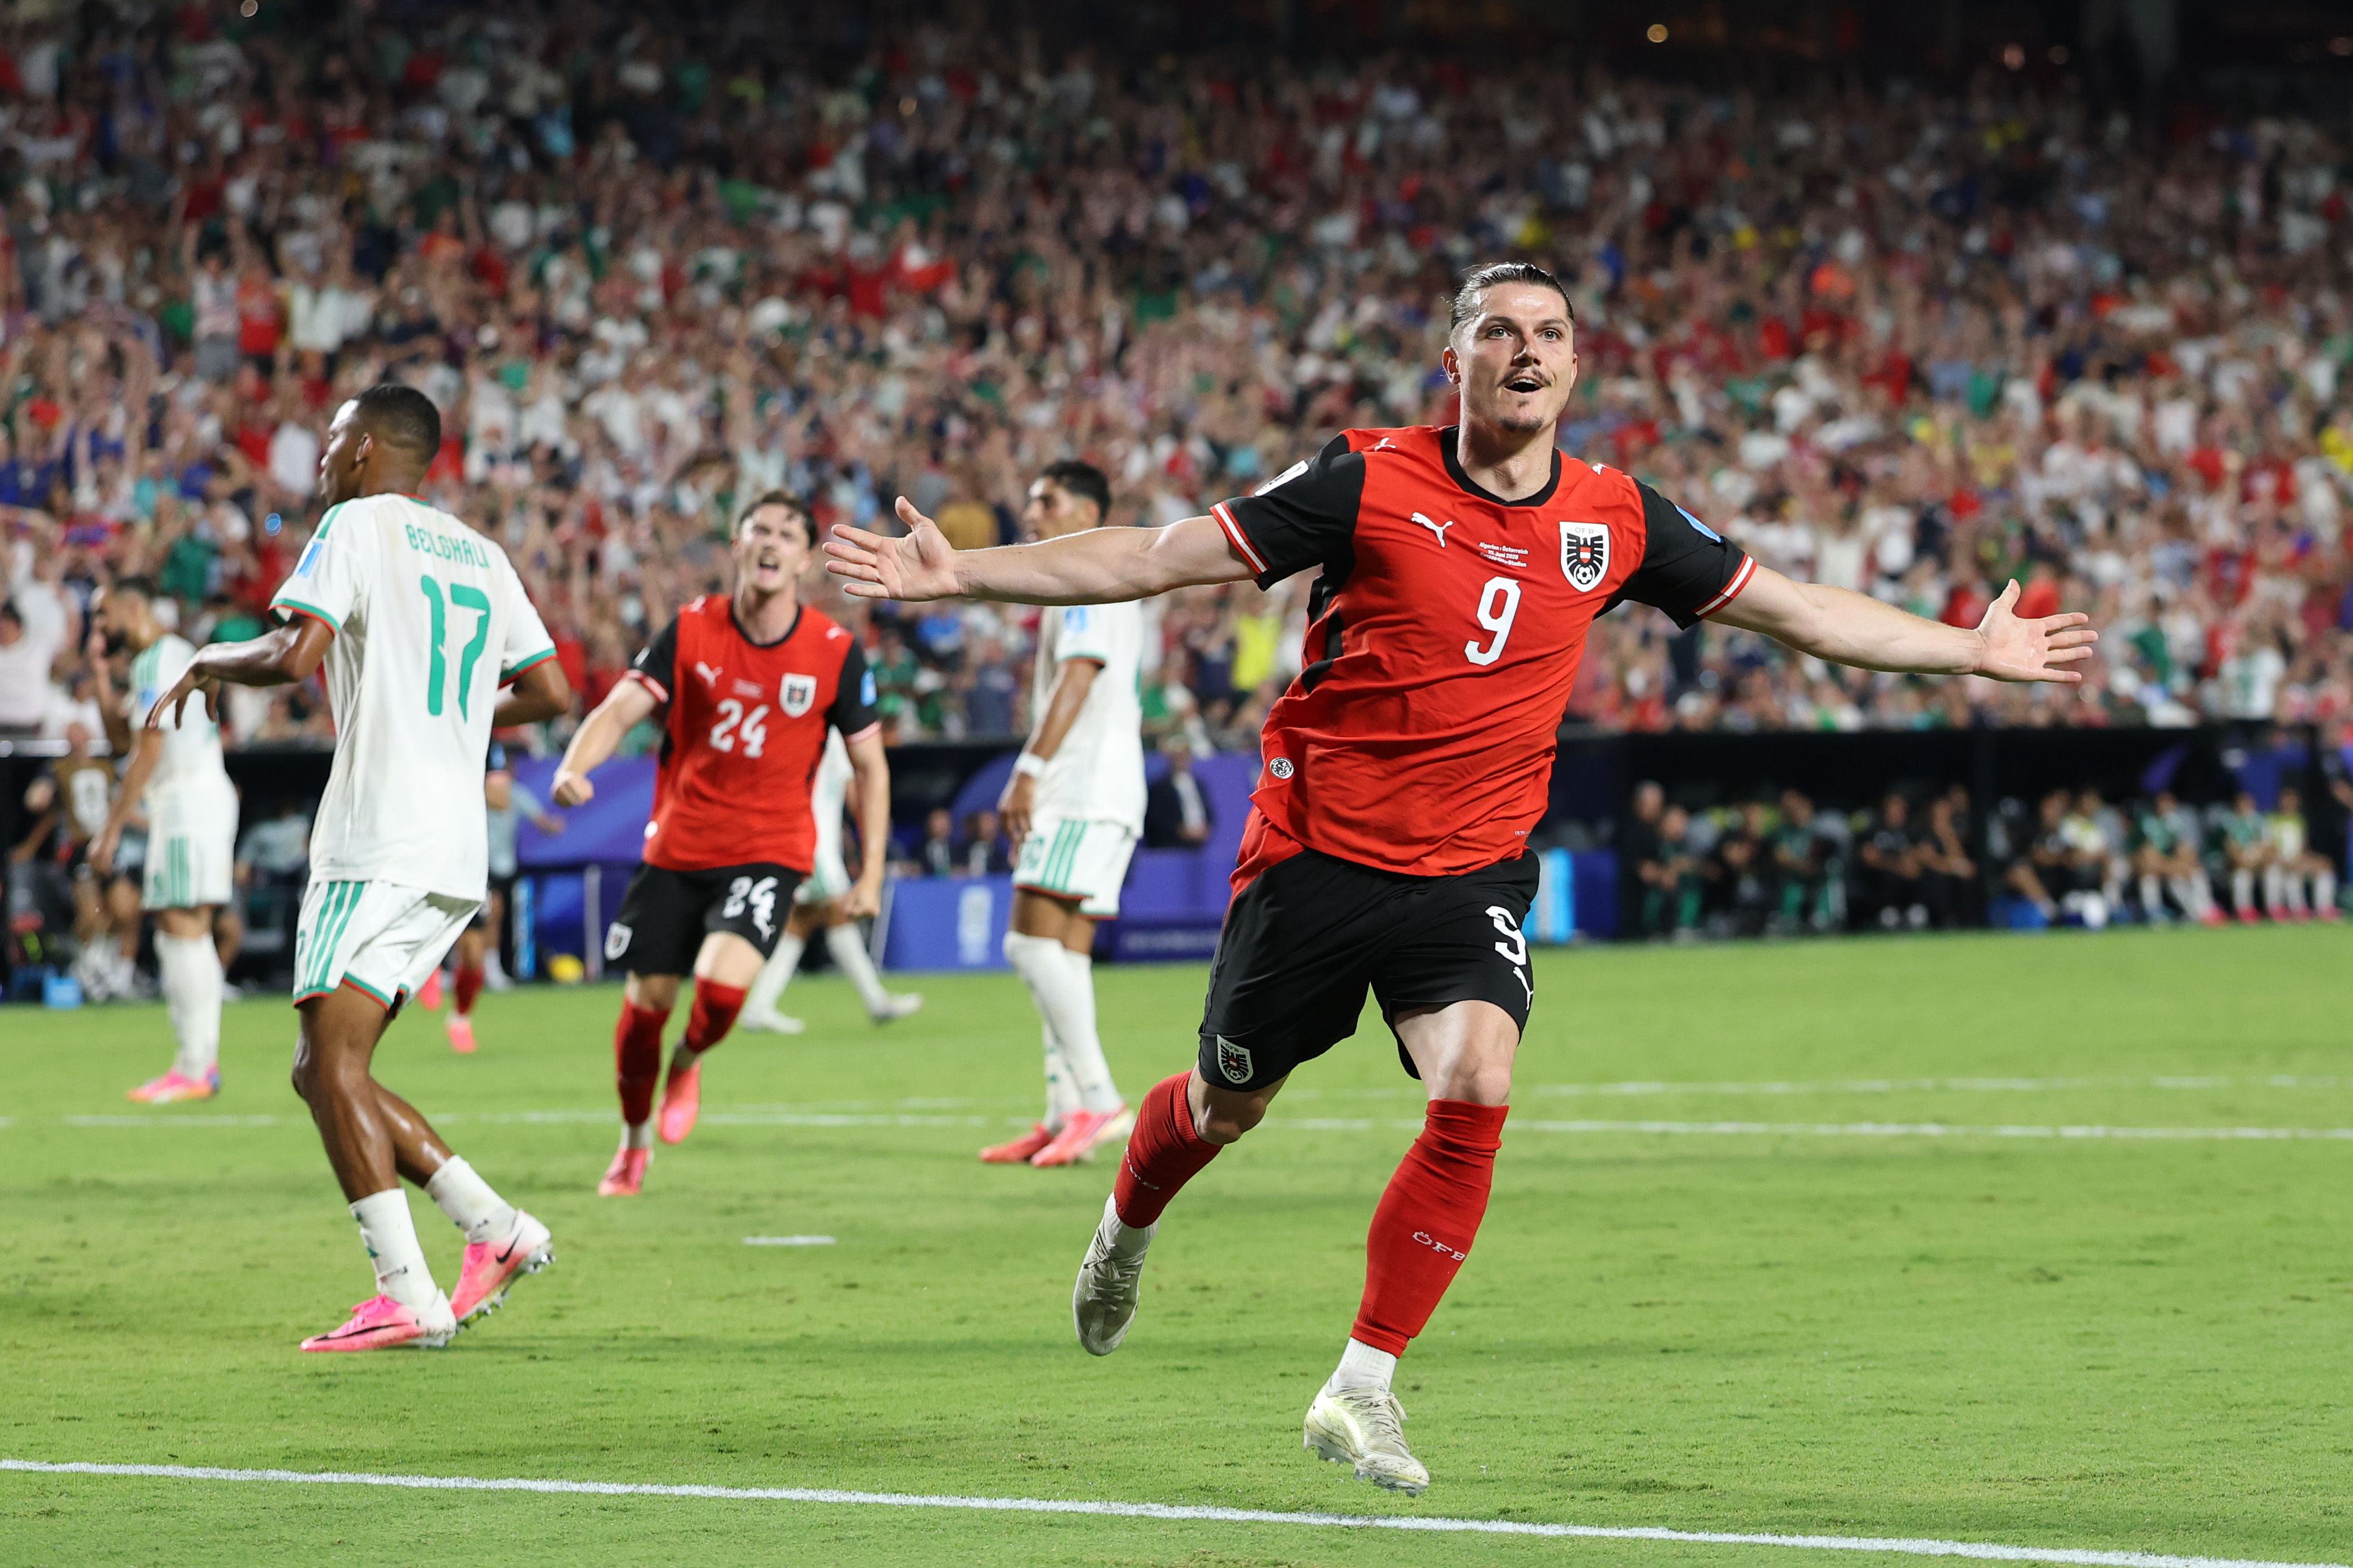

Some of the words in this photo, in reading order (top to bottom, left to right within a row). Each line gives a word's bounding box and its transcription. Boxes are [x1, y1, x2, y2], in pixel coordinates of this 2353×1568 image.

[406, 525, 489, 569] BELGHALI
[1502, 546, 1529, 554] Österreich
[1464, 576, 1521, 667] 9
[420, 575, 491, 724] 17
[709, 698, 770, 758] 24
[722, 875, 779, 921] 24
[1485, 905, 1527, 965] 9
[1412, 1231, 1466, 1261] ÖFB
